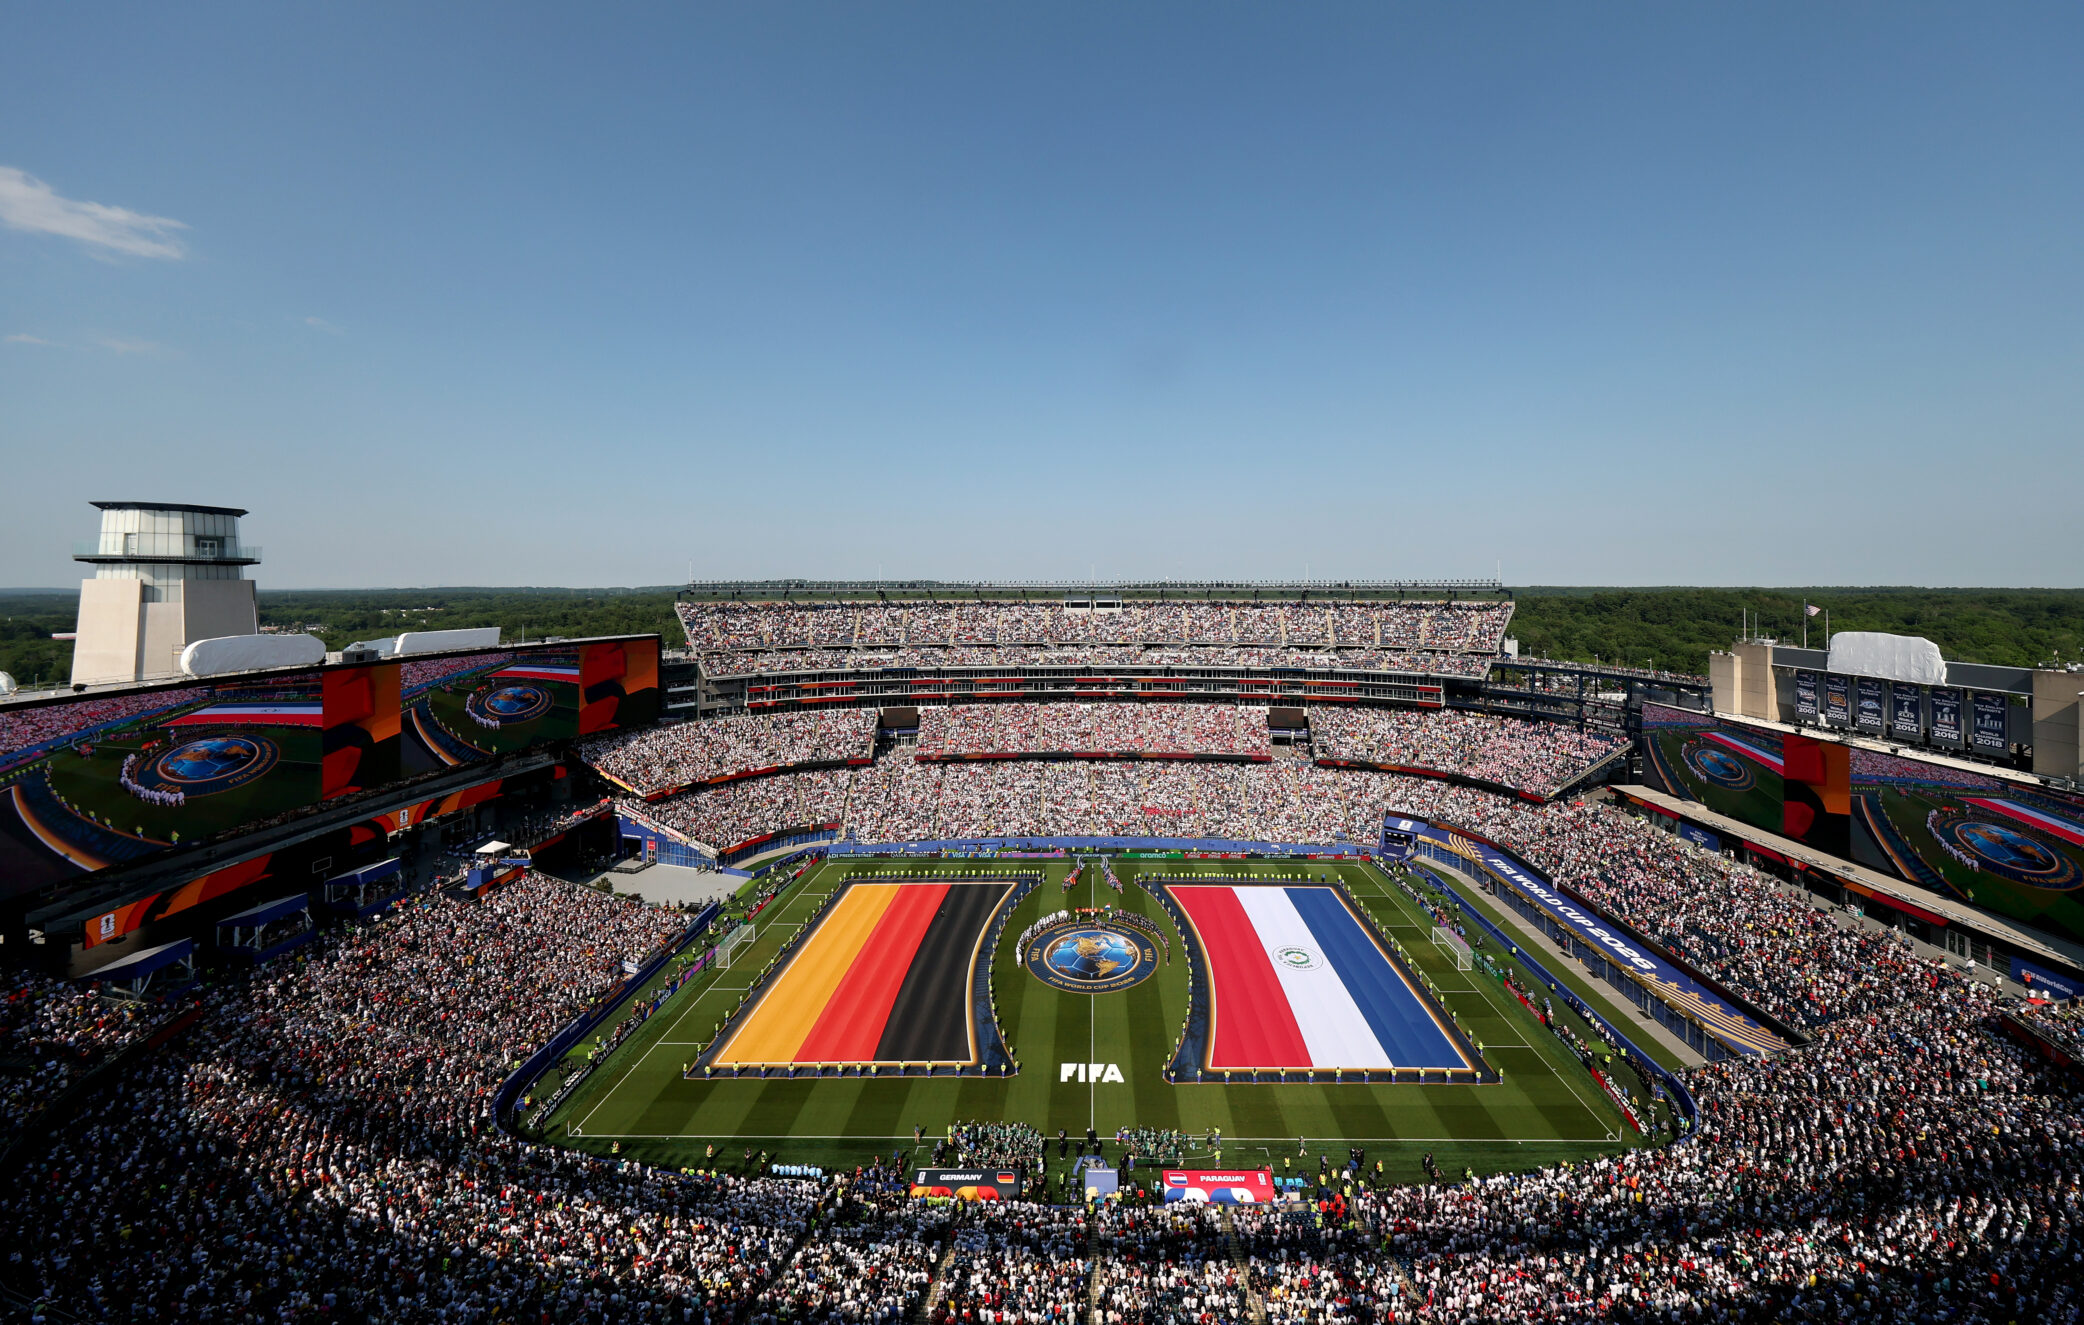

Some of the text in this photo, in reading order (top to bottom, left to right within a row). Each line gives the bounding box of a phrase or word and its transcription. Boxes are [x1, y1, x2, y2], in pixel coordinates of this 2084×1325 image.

[1896, 724, 1917, 733] 2014
[1934, 731, 1958, 740] 2016
[1976, 738, 2002, 747] 2018
[1488, 859, 1657, 969] FIFA WORLD CUP 2026
[1031, 948, 1040, 962] FIFA
[1144, 948, 1153, 962] FIFA
[1048, 976, 1063, 986] FIFA
[1110, 977, 1135, 988] 2026
[658, 990, 671, 1005] VISA
[597, 1042, 617, 1064] QATAR
[1060, 1063, 1124, 1083] FIFA
[544, 1102, 557, 1120] ADI
